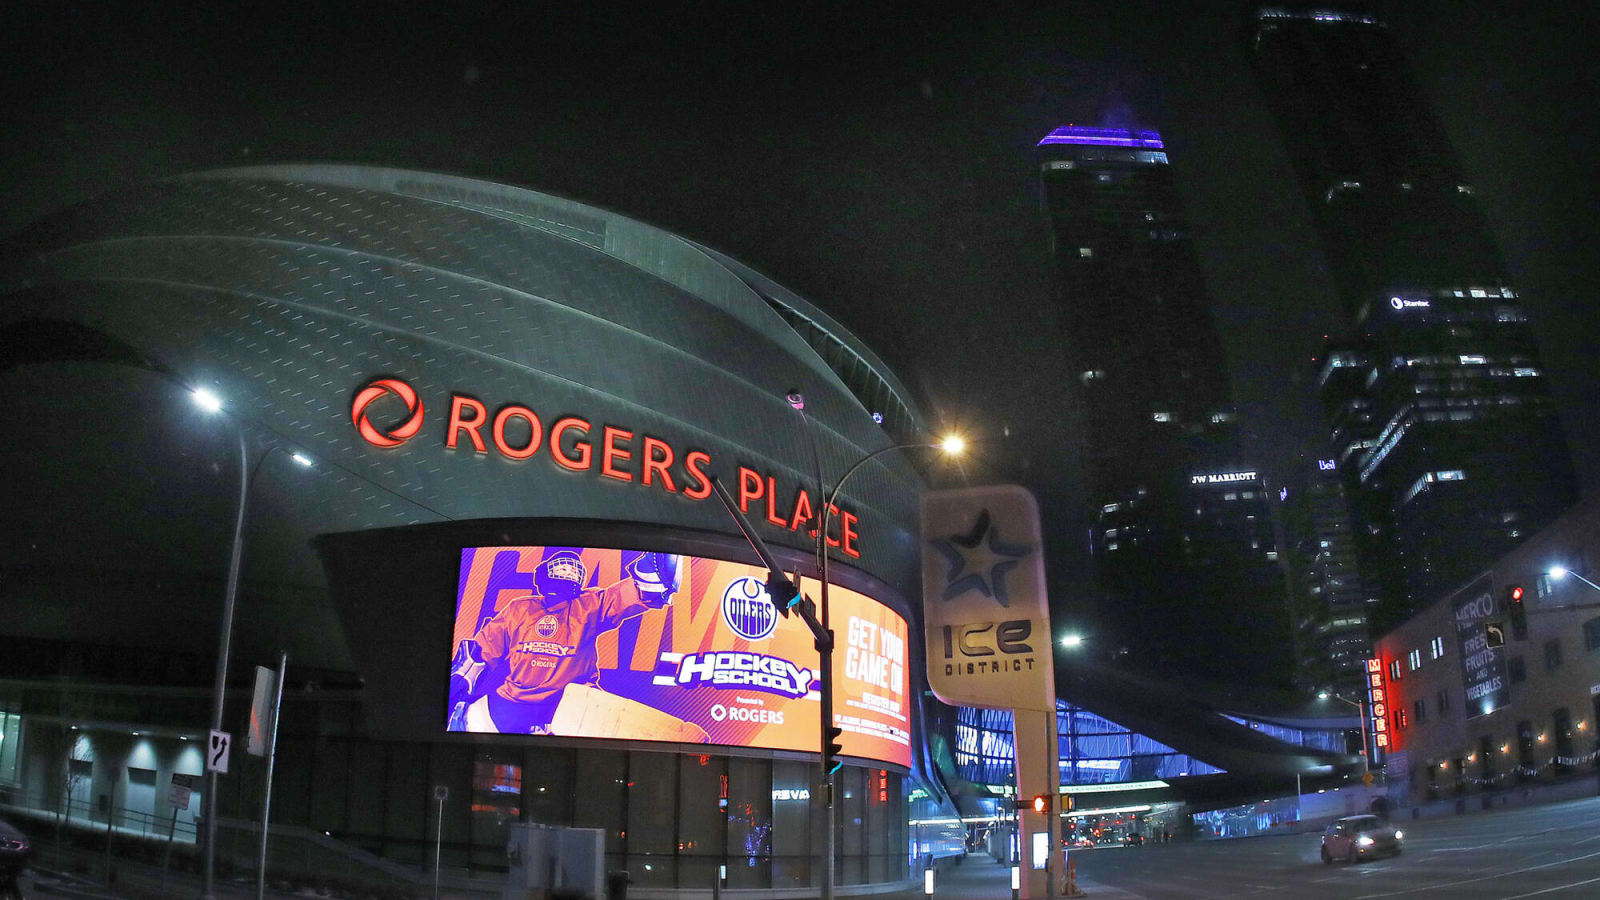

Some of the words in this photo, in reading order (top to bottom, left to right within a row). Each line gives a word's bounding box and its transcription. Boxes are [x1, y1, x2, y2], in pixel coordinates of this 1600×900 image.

[445, 394, 713, 501] ROGERS
[739, 466, 860, 559] PLACE
[1191, 475, 1206, 484] JW
[1208, 471, 1257, 483] MARRIOTT
[730, 597, 771, 635] OILERS
[848, 615, 878, 652] GET
[1464, 633, 1487, 656] FRES
[678, 652, 812, 694] HOCKEY
[713, 671, 799, 694] SCHOOL
[845, 646, 889, 689] GAME
[945, 658, 1036, 676] DISTRICT
[729, 706, 784, 724] ROGERS
[1368, 658, 1388, 747] MERCER
